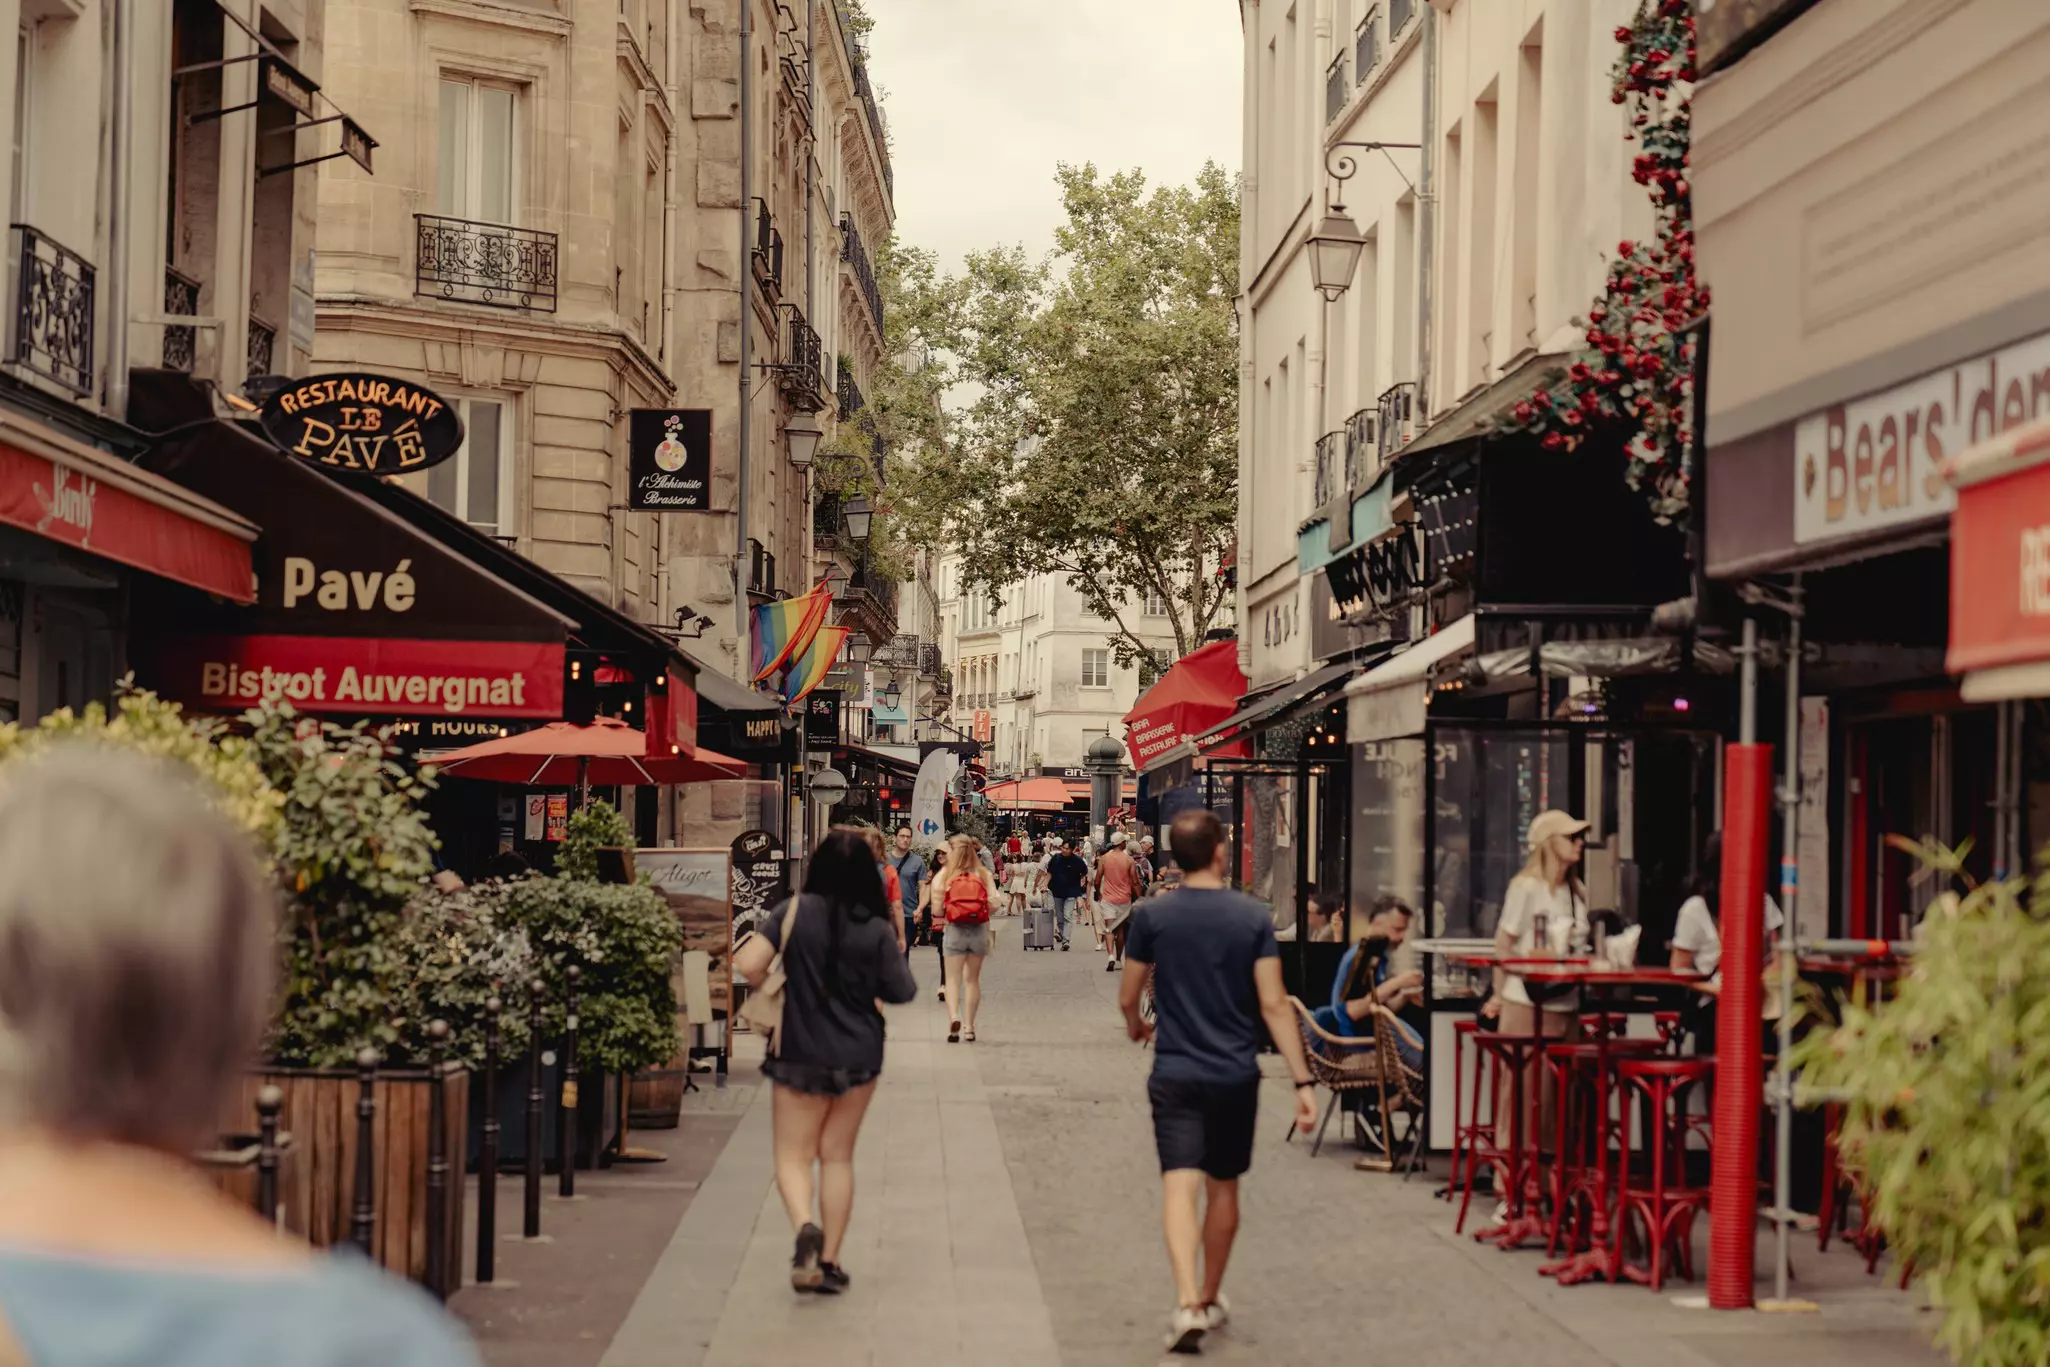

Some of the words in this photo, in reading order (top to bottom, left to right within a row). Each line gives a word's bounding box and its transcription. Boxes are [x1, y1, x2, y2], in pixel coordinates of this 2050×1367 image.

[279, 379, 443, 420] RESTAURANT
[339, 407, 383, 431] LE
[293, 417, 426, 471] PAVÉ
[643, 490, 697, 505] Brasserie
[283, 557, 415, 613] Pavé
[202, 662, 326, 700] Bistrot
[334, 666, 526, 713] Auvergnat
[746, 720, 773, 737] HAPPY
[1131, 718, 1150, 732] BAR
[1135, 722, 1176, 745] BRASSERIE
